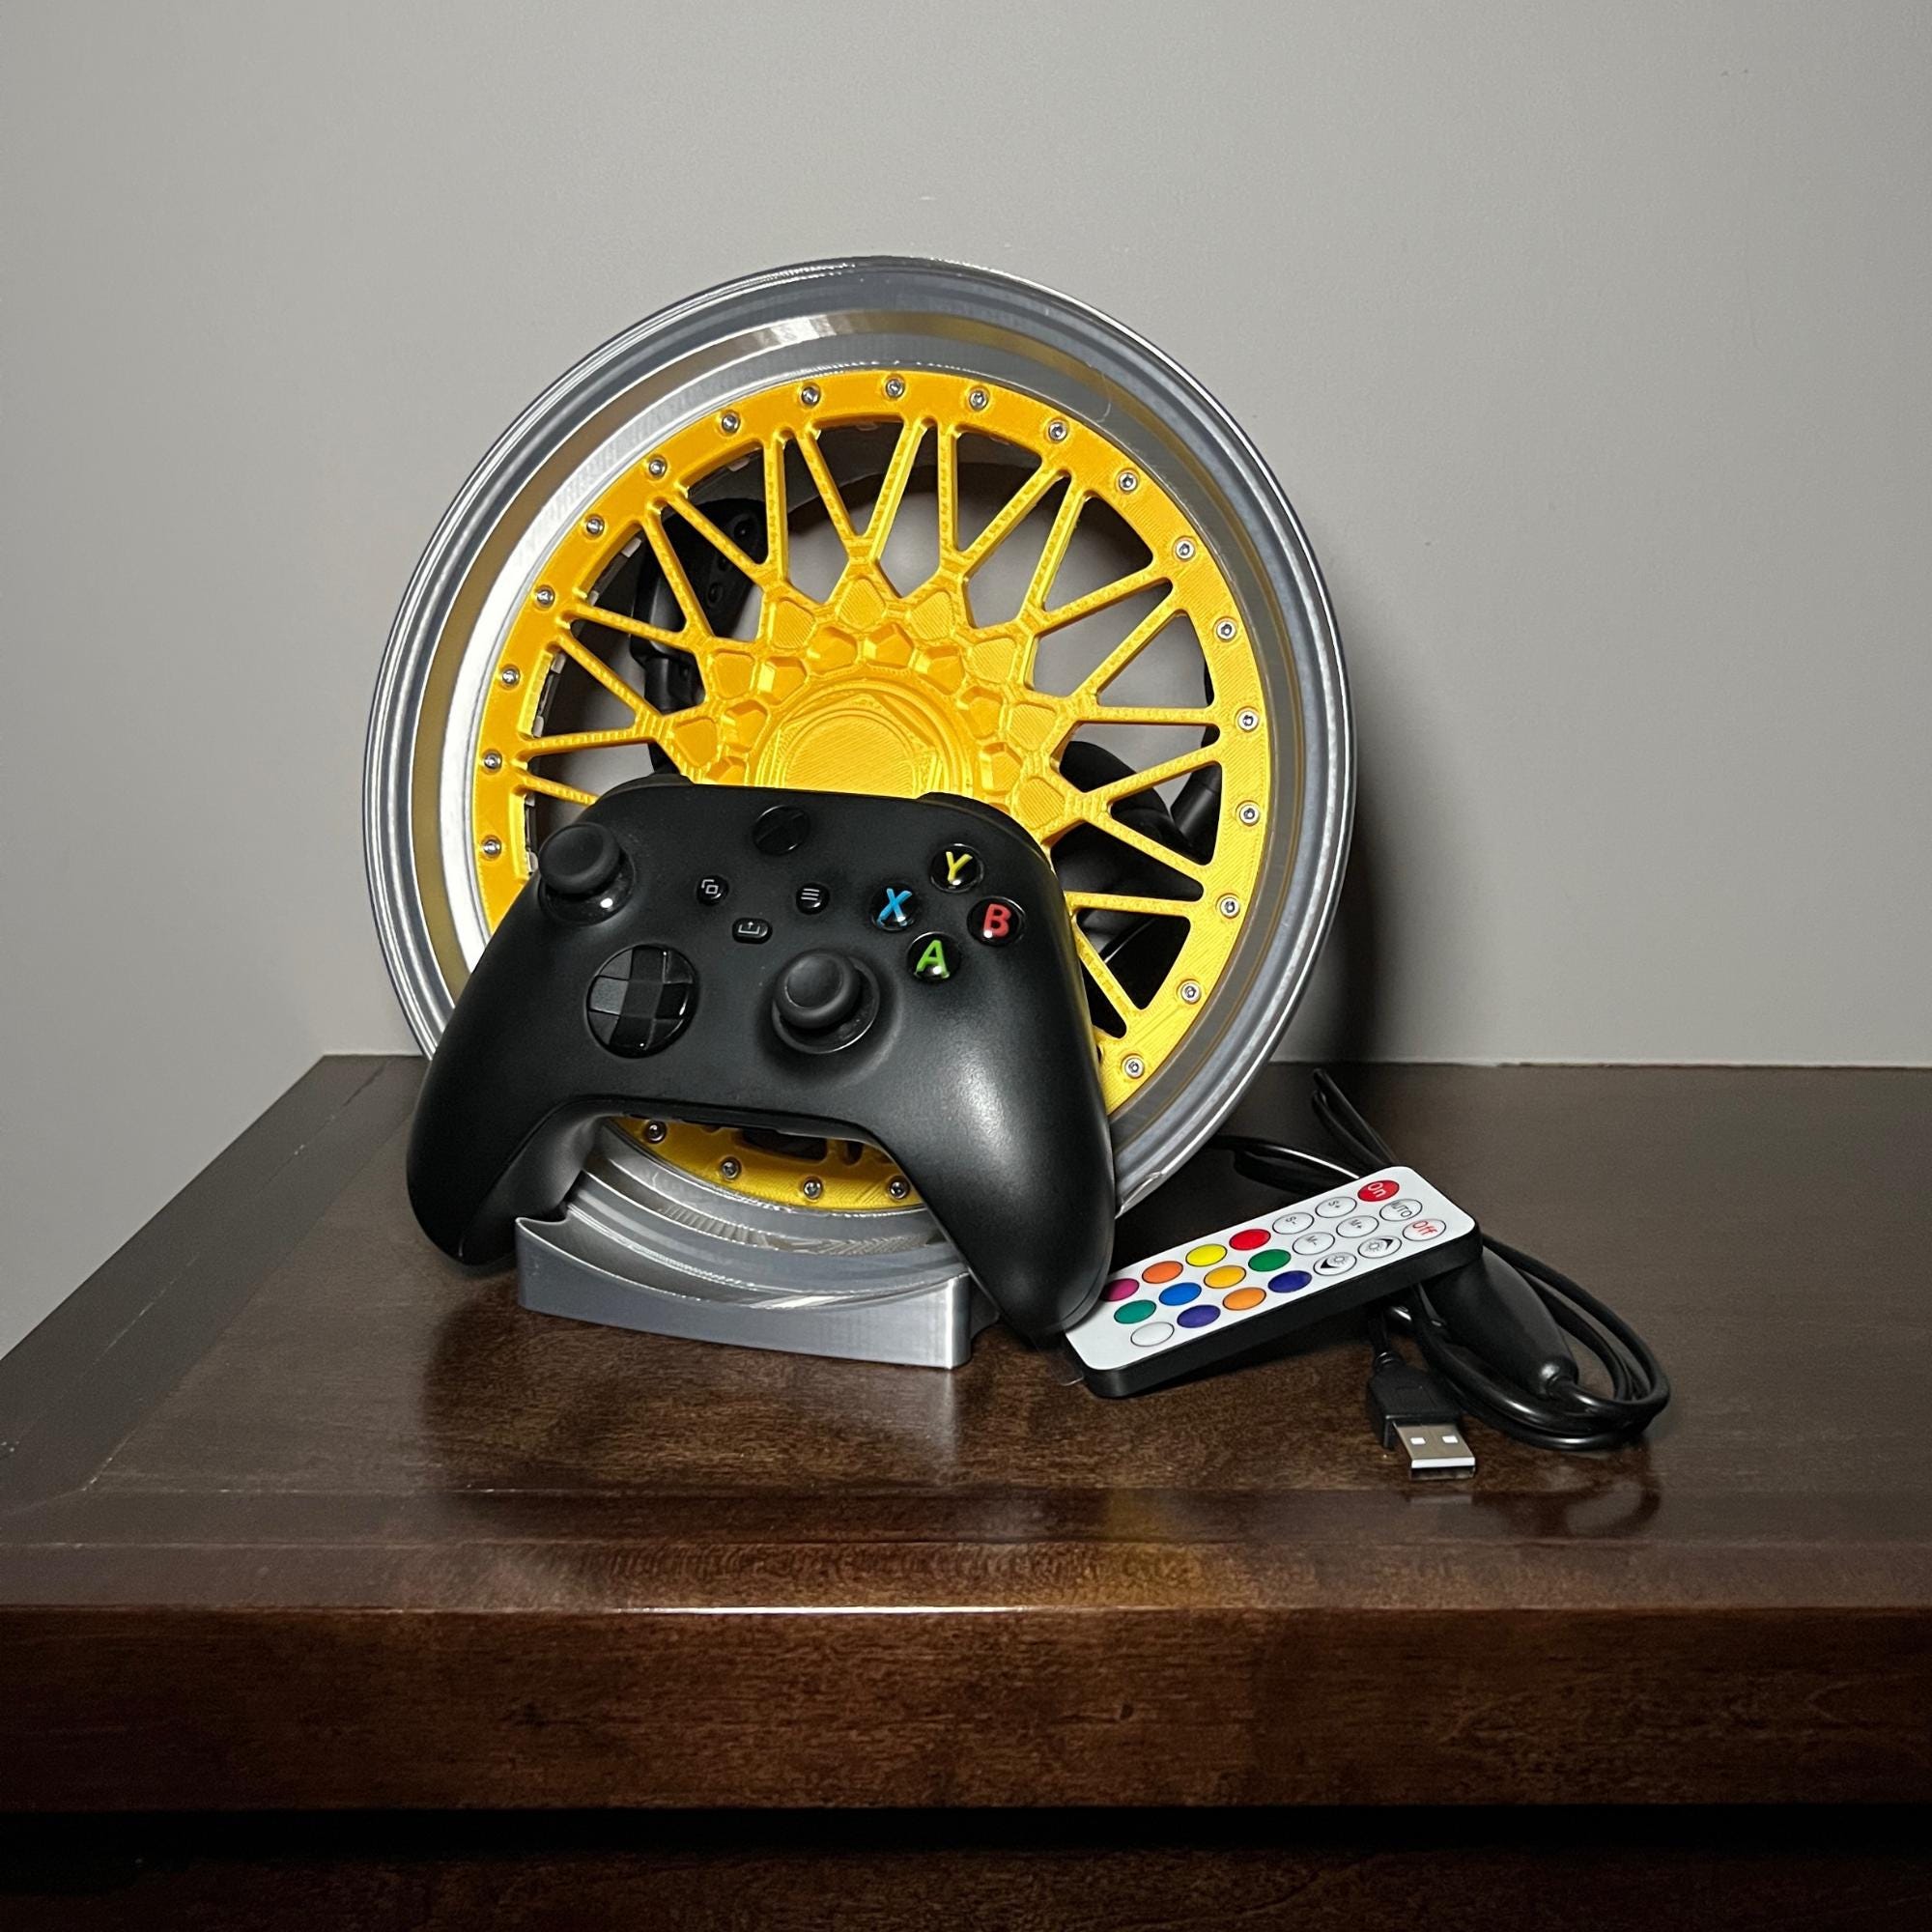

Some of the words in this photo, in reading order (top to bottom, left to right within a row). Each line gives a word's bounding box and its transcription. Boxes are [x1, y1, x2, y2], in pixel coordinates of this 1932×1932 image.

[946, 851, 973, 883] Y
[877, 888, 913, 925] X
[983, 903, 1011, 938] B
[915, 939, 950, 978] A
[1368, 1181, 1386, 1198] On
[1412, 1220, 1437, 1236] Off
